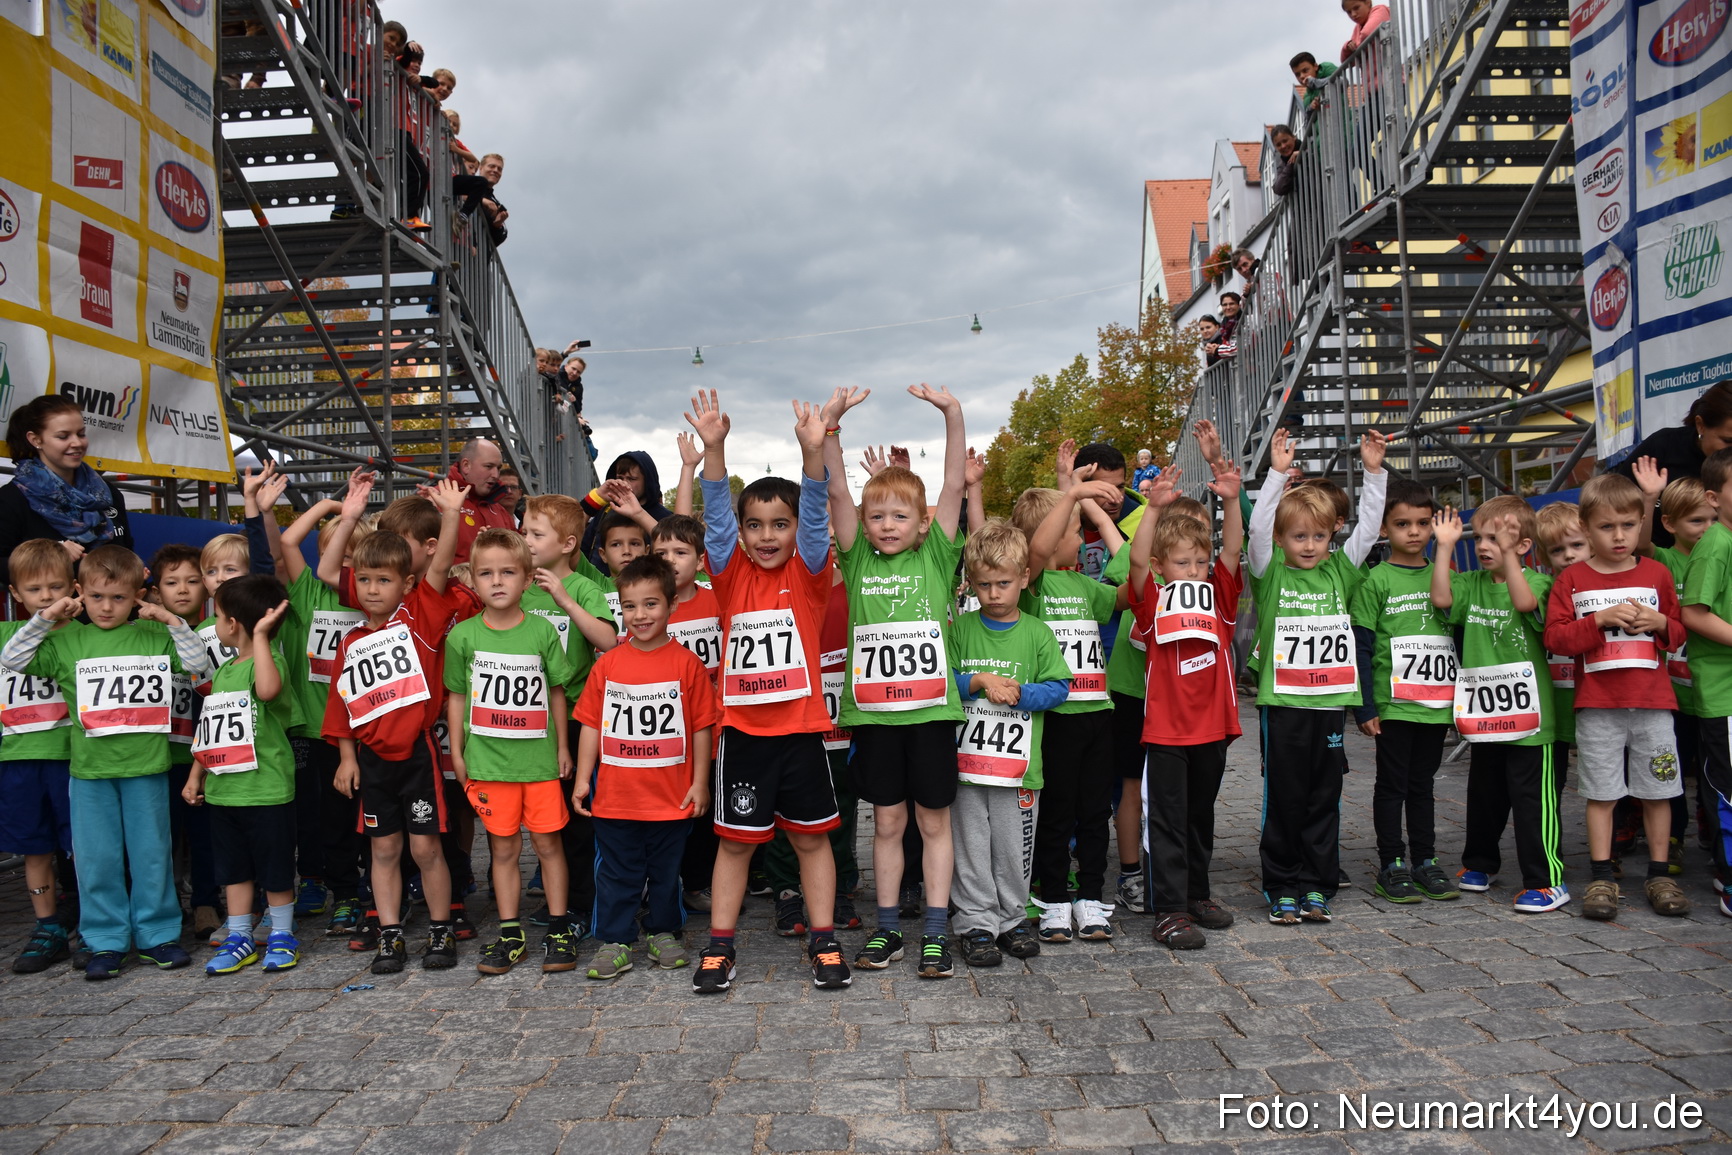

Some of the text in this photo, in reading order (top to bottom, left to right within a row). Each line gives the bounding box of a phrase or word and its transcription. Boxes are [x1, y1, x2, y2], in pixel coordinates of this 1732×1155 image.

[1662, 0, 1726, 55] Hervis
[87, 165, 111, 181] DEHN
[1582, 156, 1619, 188] GERHART
[162, 168, 206, 218] Hervis
[1603, 207, 1619, 228] KIA
[1667, 220, 1718, 267] RUND
[1665, 251, 1725, 300] SCHAU
[80, 274, 110, 309] Braun
[160, 310, 200, 337] Neumarkter
[152, 322, 205, 358] Lammsbräu
[1648, 371, 1700, 393] Neumarkter
[82, 416, 125, 433] erke neumarkt
[150, 403, 219, 435] NATHUS
[861, 585, 900, 596] tadtlauf
[1386, 601, 1427, 615] Stadtlauf
[1575, 598, 1602, 609] PARTL
[680, 626, 714, 637] Neumarkt
[743, 619, 783, 631] Neumarkt
[1181, 616, 1212, 630] Lukas
[856, 631, 926, 642] PARTL Neumarkt
[1053, 629, 1072, 637] RTL
[355, 636, 396, 656] Neumarkt
[730, 631, 793, 670] 7217
[1284, 634, 1348, 665] 7126
[475, 659, 538, 672] PARTL Neumarkt
[828, 652, 843, 662] DEHN
[861, 642, 937, 679] 7039
[1191, 657, 1208, 668] DEHN
[79, 664, 155, 675] PARTL Neumarkt
[342, 645, 412, 696] 7058
[1402, 654, 1457, 682] 7408
[1479, 671, 1519, 682] Neumarkt
[739, 675, 787, 692] Raphael
[1072, 677, 1099, 689] Kilian
[1309, 672, 1328, 684] Tim
[6, 674, 62, 705] 743
[87, 675, 163, 706] 7423
[368, 689, 397, 706] Vitus
[479, 673, 543, 706] 7082
[607, 689, 666, 702] PARTL Neumarkt
[885, 686, 912, 699] Finn
[1464, 682, 1531, 714] 7096
[491, 713, 526, 727] Niklas
[611, 703, 676, 736] 7192
[976, 707, 1018, 719] Neumarkt
[1477, 720, 1516, 731] Marlon
[958, 719, 1024, 754] 7442
[620, 743, 660, 757] Patrick
[203, 753, 227, 765] Timur
[474, 805, 492, 817] FCB
